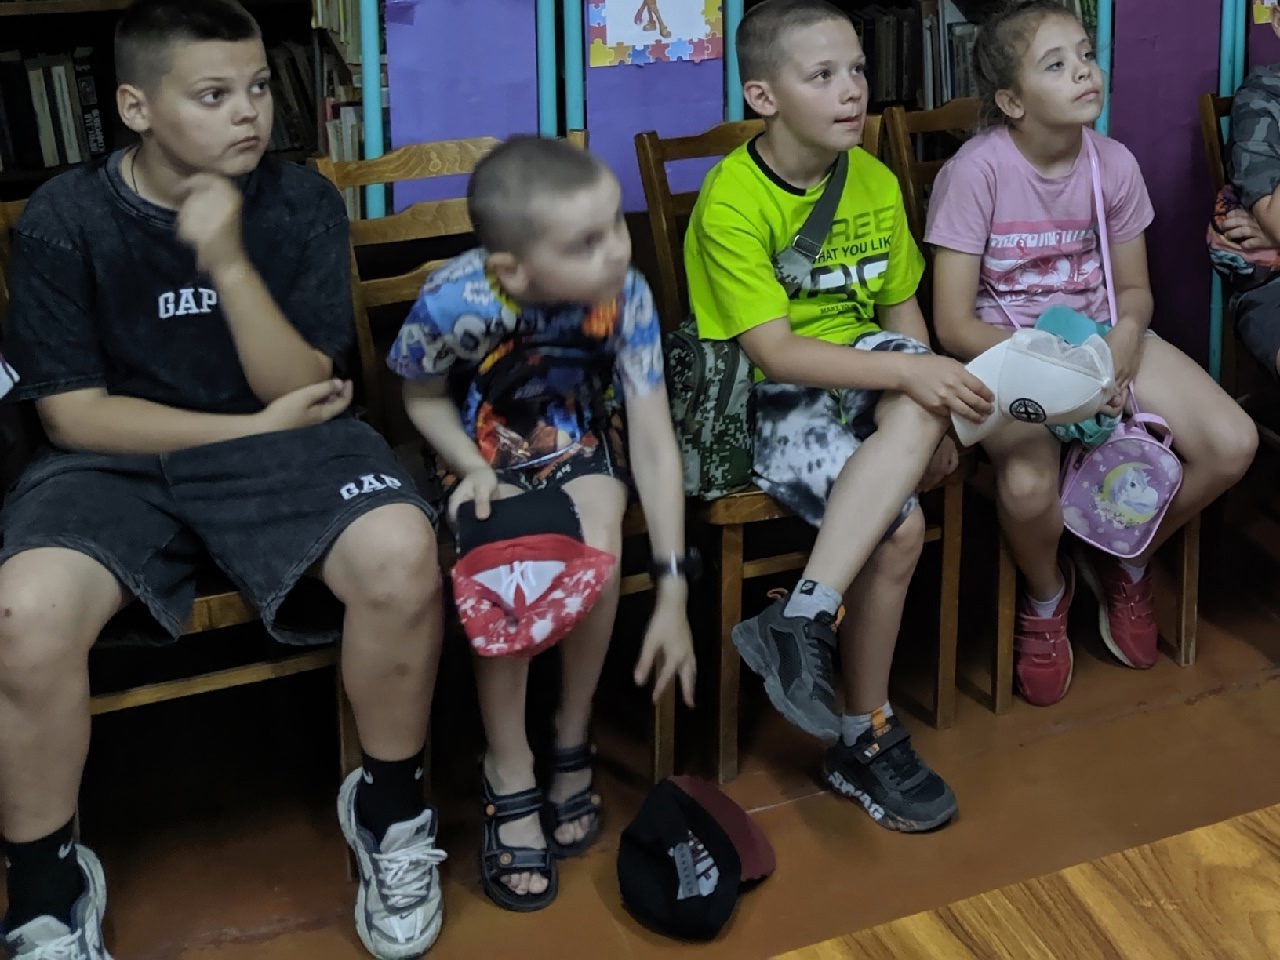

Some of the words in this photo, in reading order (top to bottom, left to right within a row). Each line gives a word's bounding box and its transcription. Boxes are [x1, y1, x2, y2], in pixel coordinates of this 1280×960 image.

[842, 241, 867, 257] YOU
[158, 288, 218, 319] GAP
[339, 474, 402, 501] GAP
